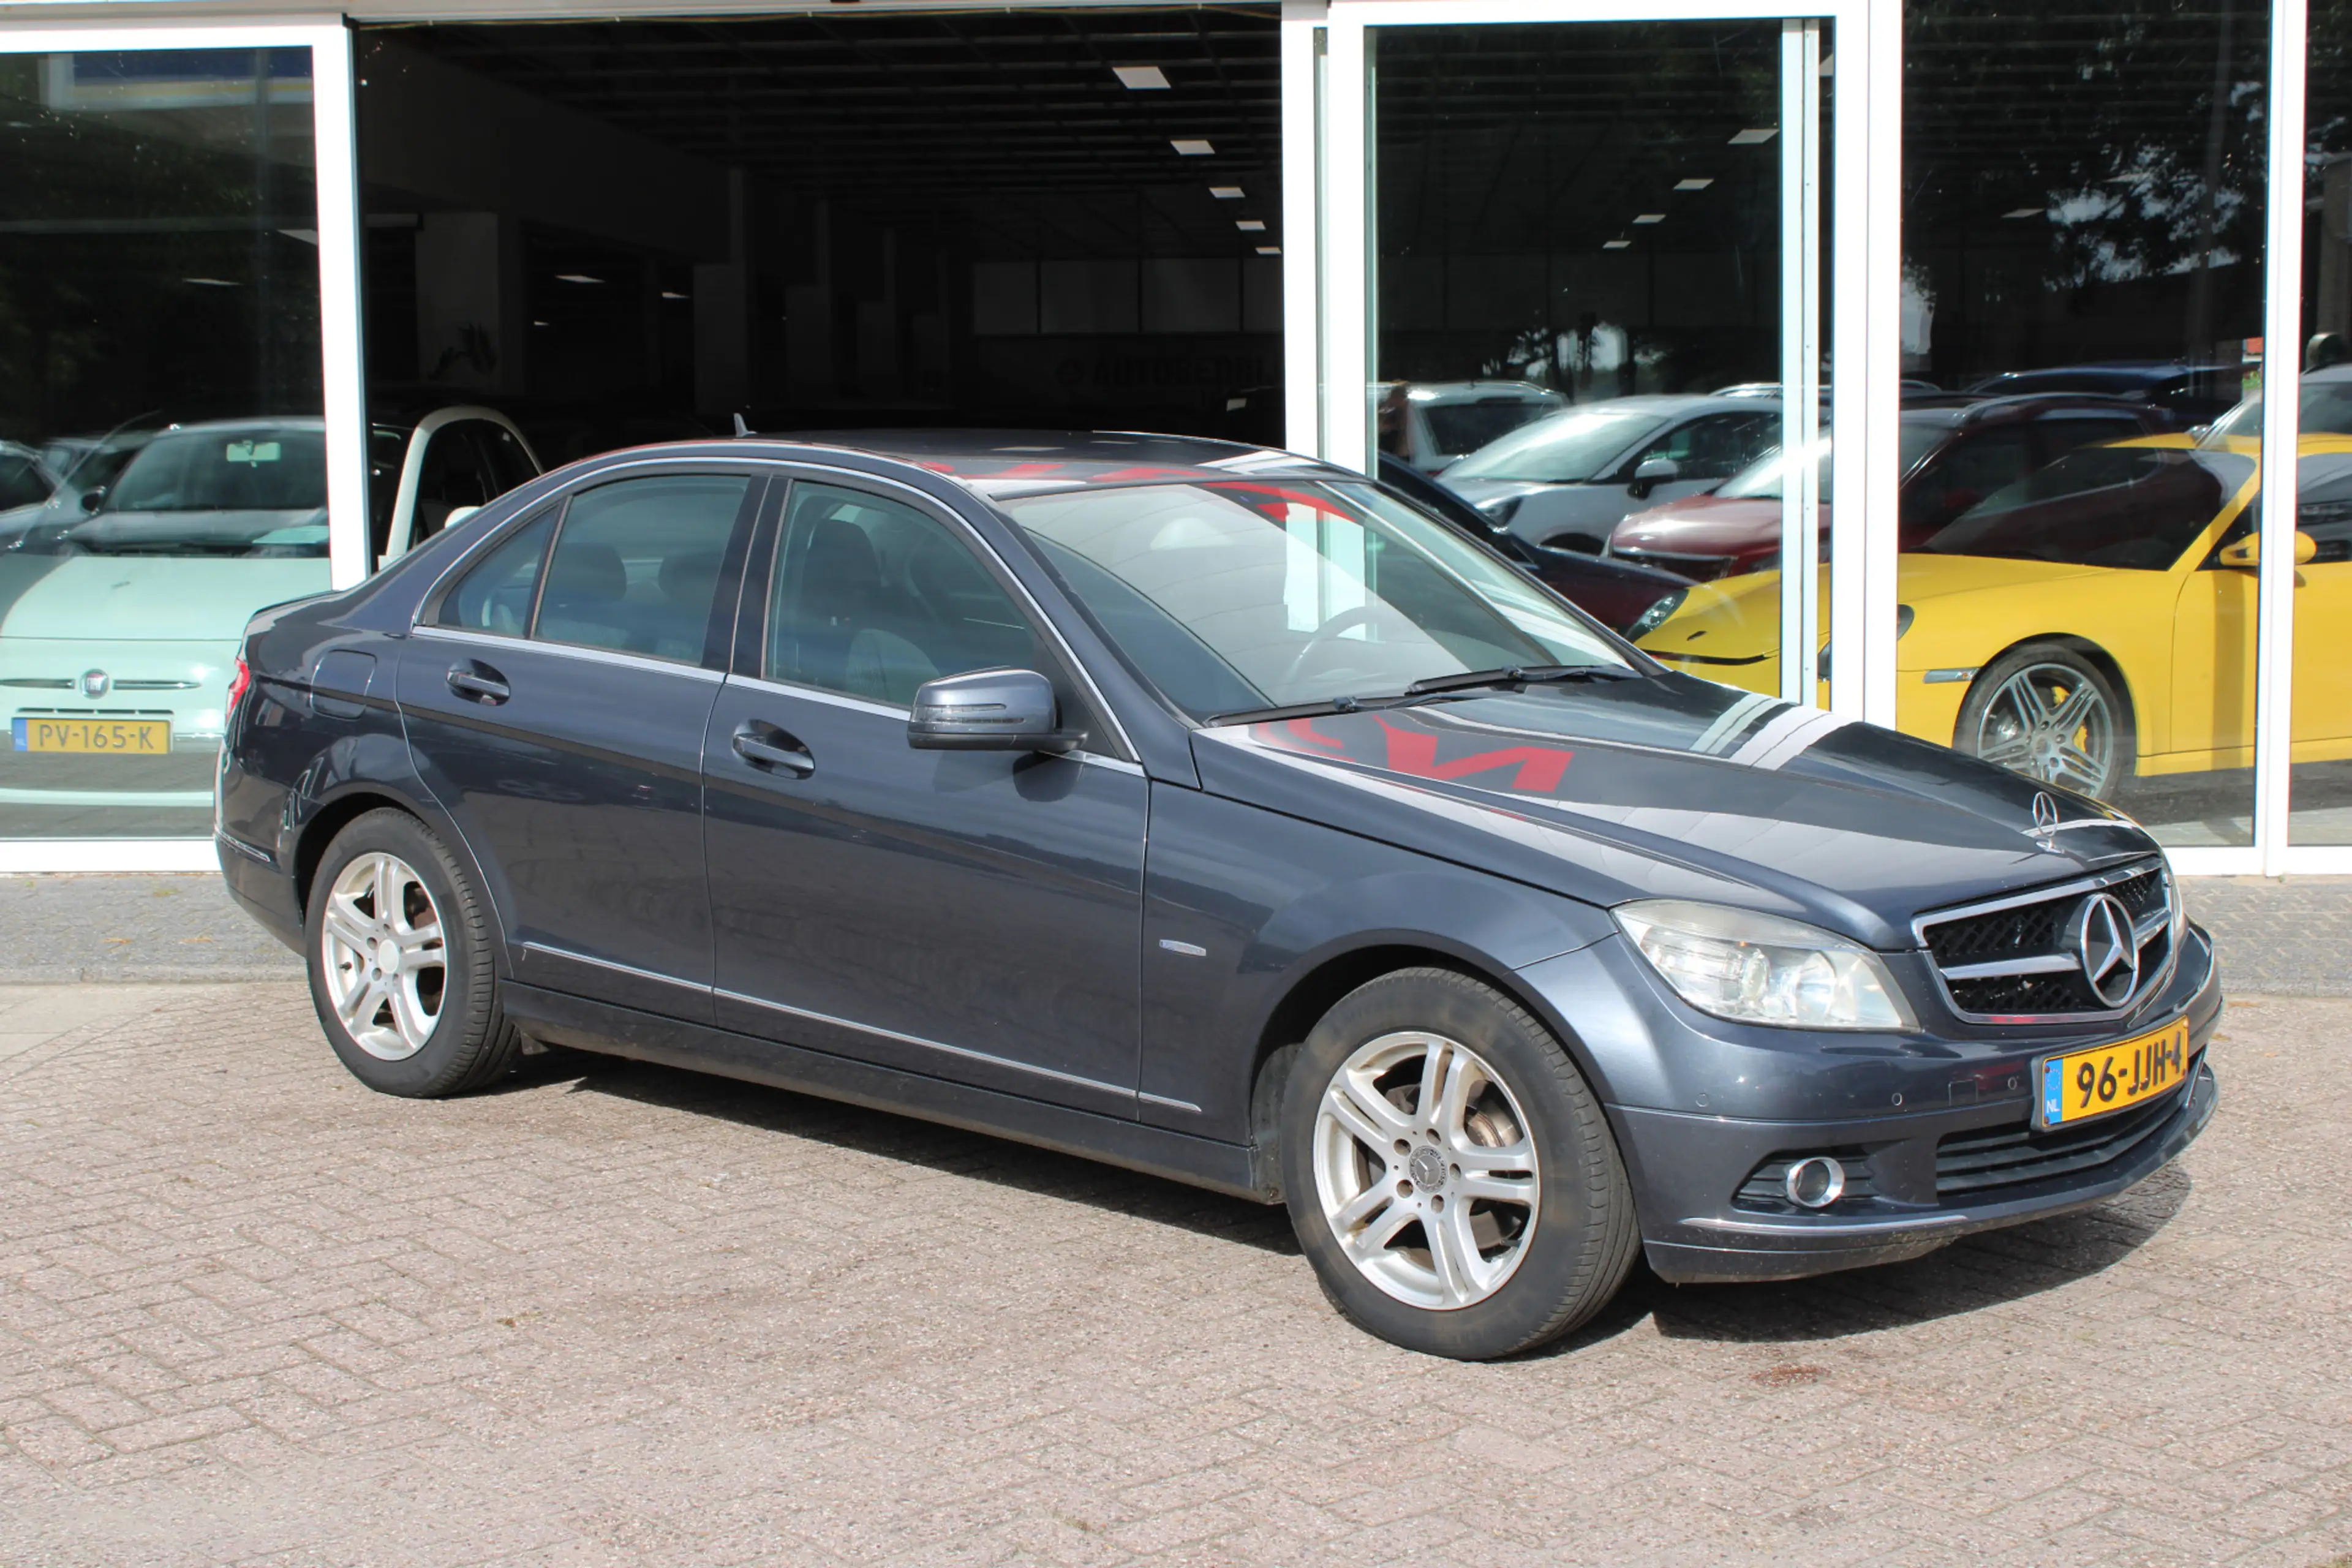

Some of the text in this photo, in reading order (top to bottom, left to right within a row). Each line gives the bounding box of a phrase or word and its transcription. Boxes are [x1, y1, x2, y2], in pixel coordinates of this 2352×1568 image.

[39, 724, 154, 750] PV-165-K
[2046, 1031, 2182, 1114] NL 96-JJH-4
